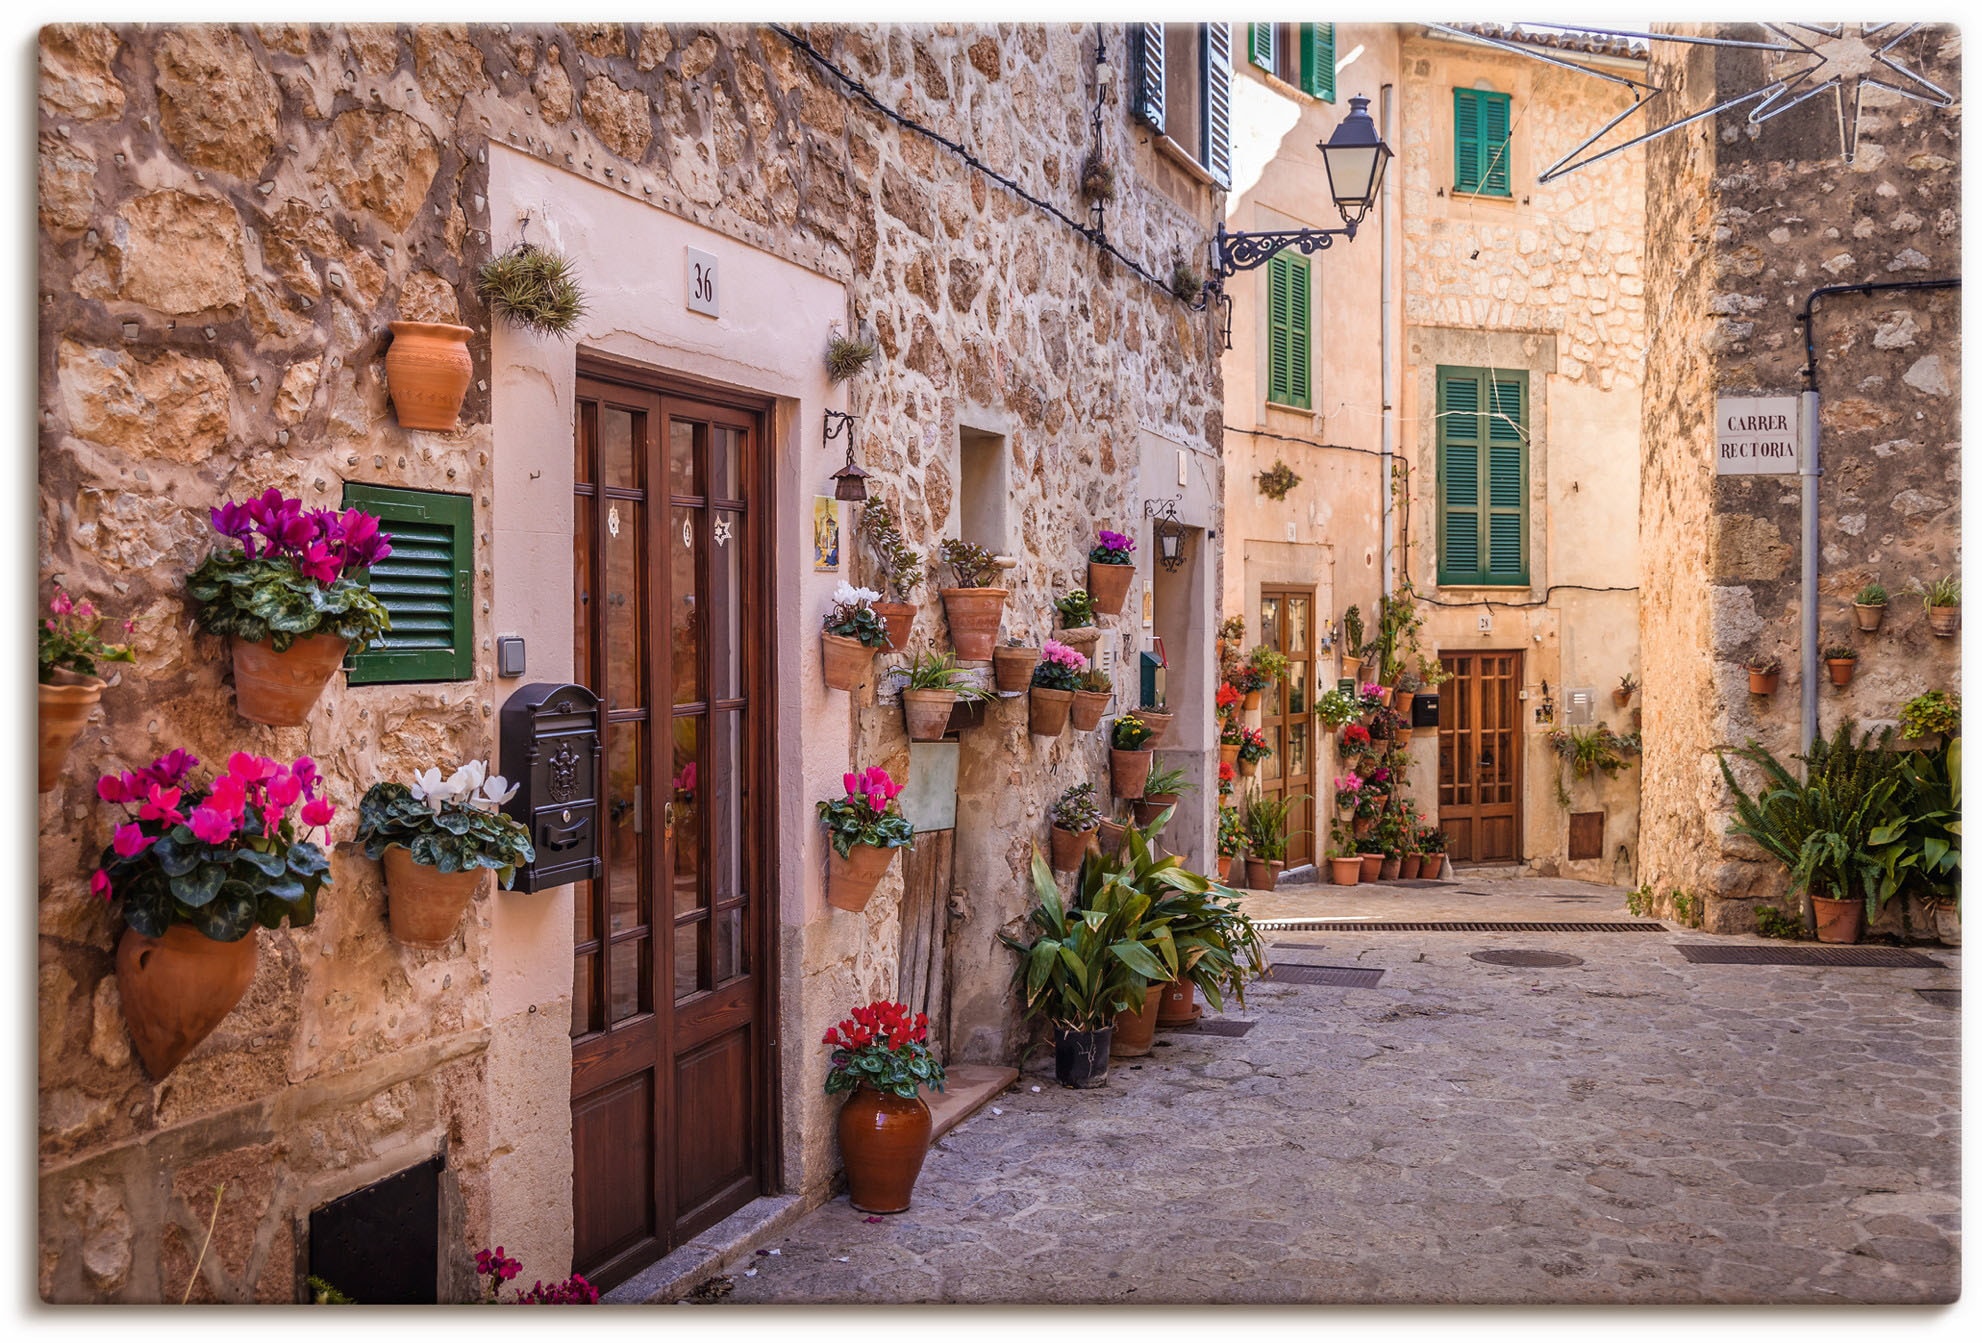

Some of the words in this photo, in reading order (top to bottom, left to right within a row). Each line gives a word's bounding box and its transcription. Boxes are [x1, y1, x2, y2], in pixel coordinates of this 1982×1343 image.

[694, 262, 712, 302] 36
[1728, 415, 1788, 431] CARRER
[1721, 442, 1794, 459] RECTORIA
